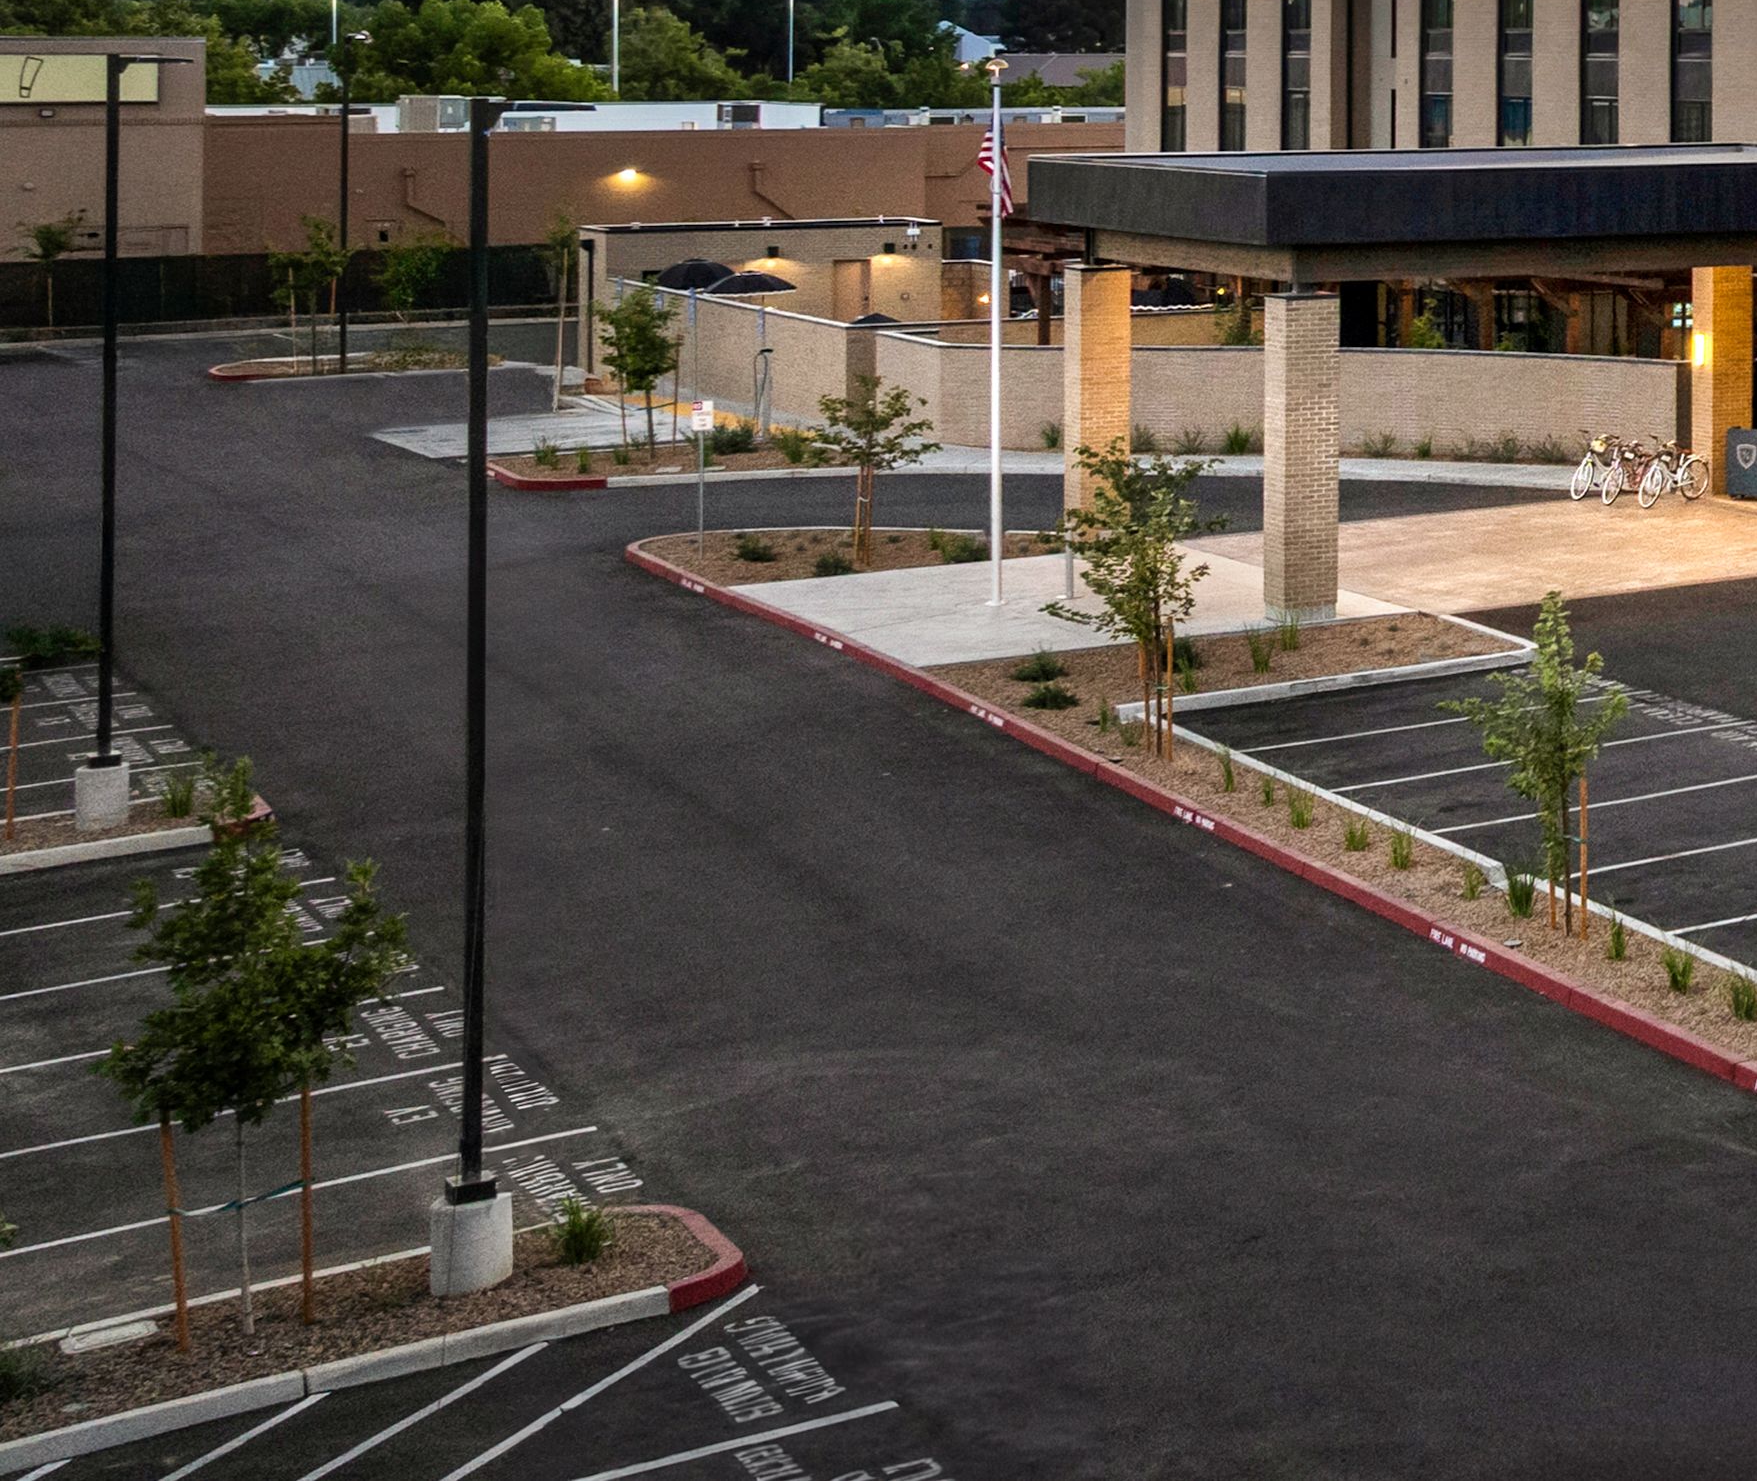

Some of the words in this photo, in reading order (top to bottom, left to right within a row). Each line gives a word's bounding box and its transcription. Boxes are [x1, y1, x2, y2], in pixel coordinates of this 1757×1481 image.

[361, 1006, 440, 1059] CHARGING
[384, 1104, 439, 1125] EV
[572, 1157, 643, 1194] ONLY
